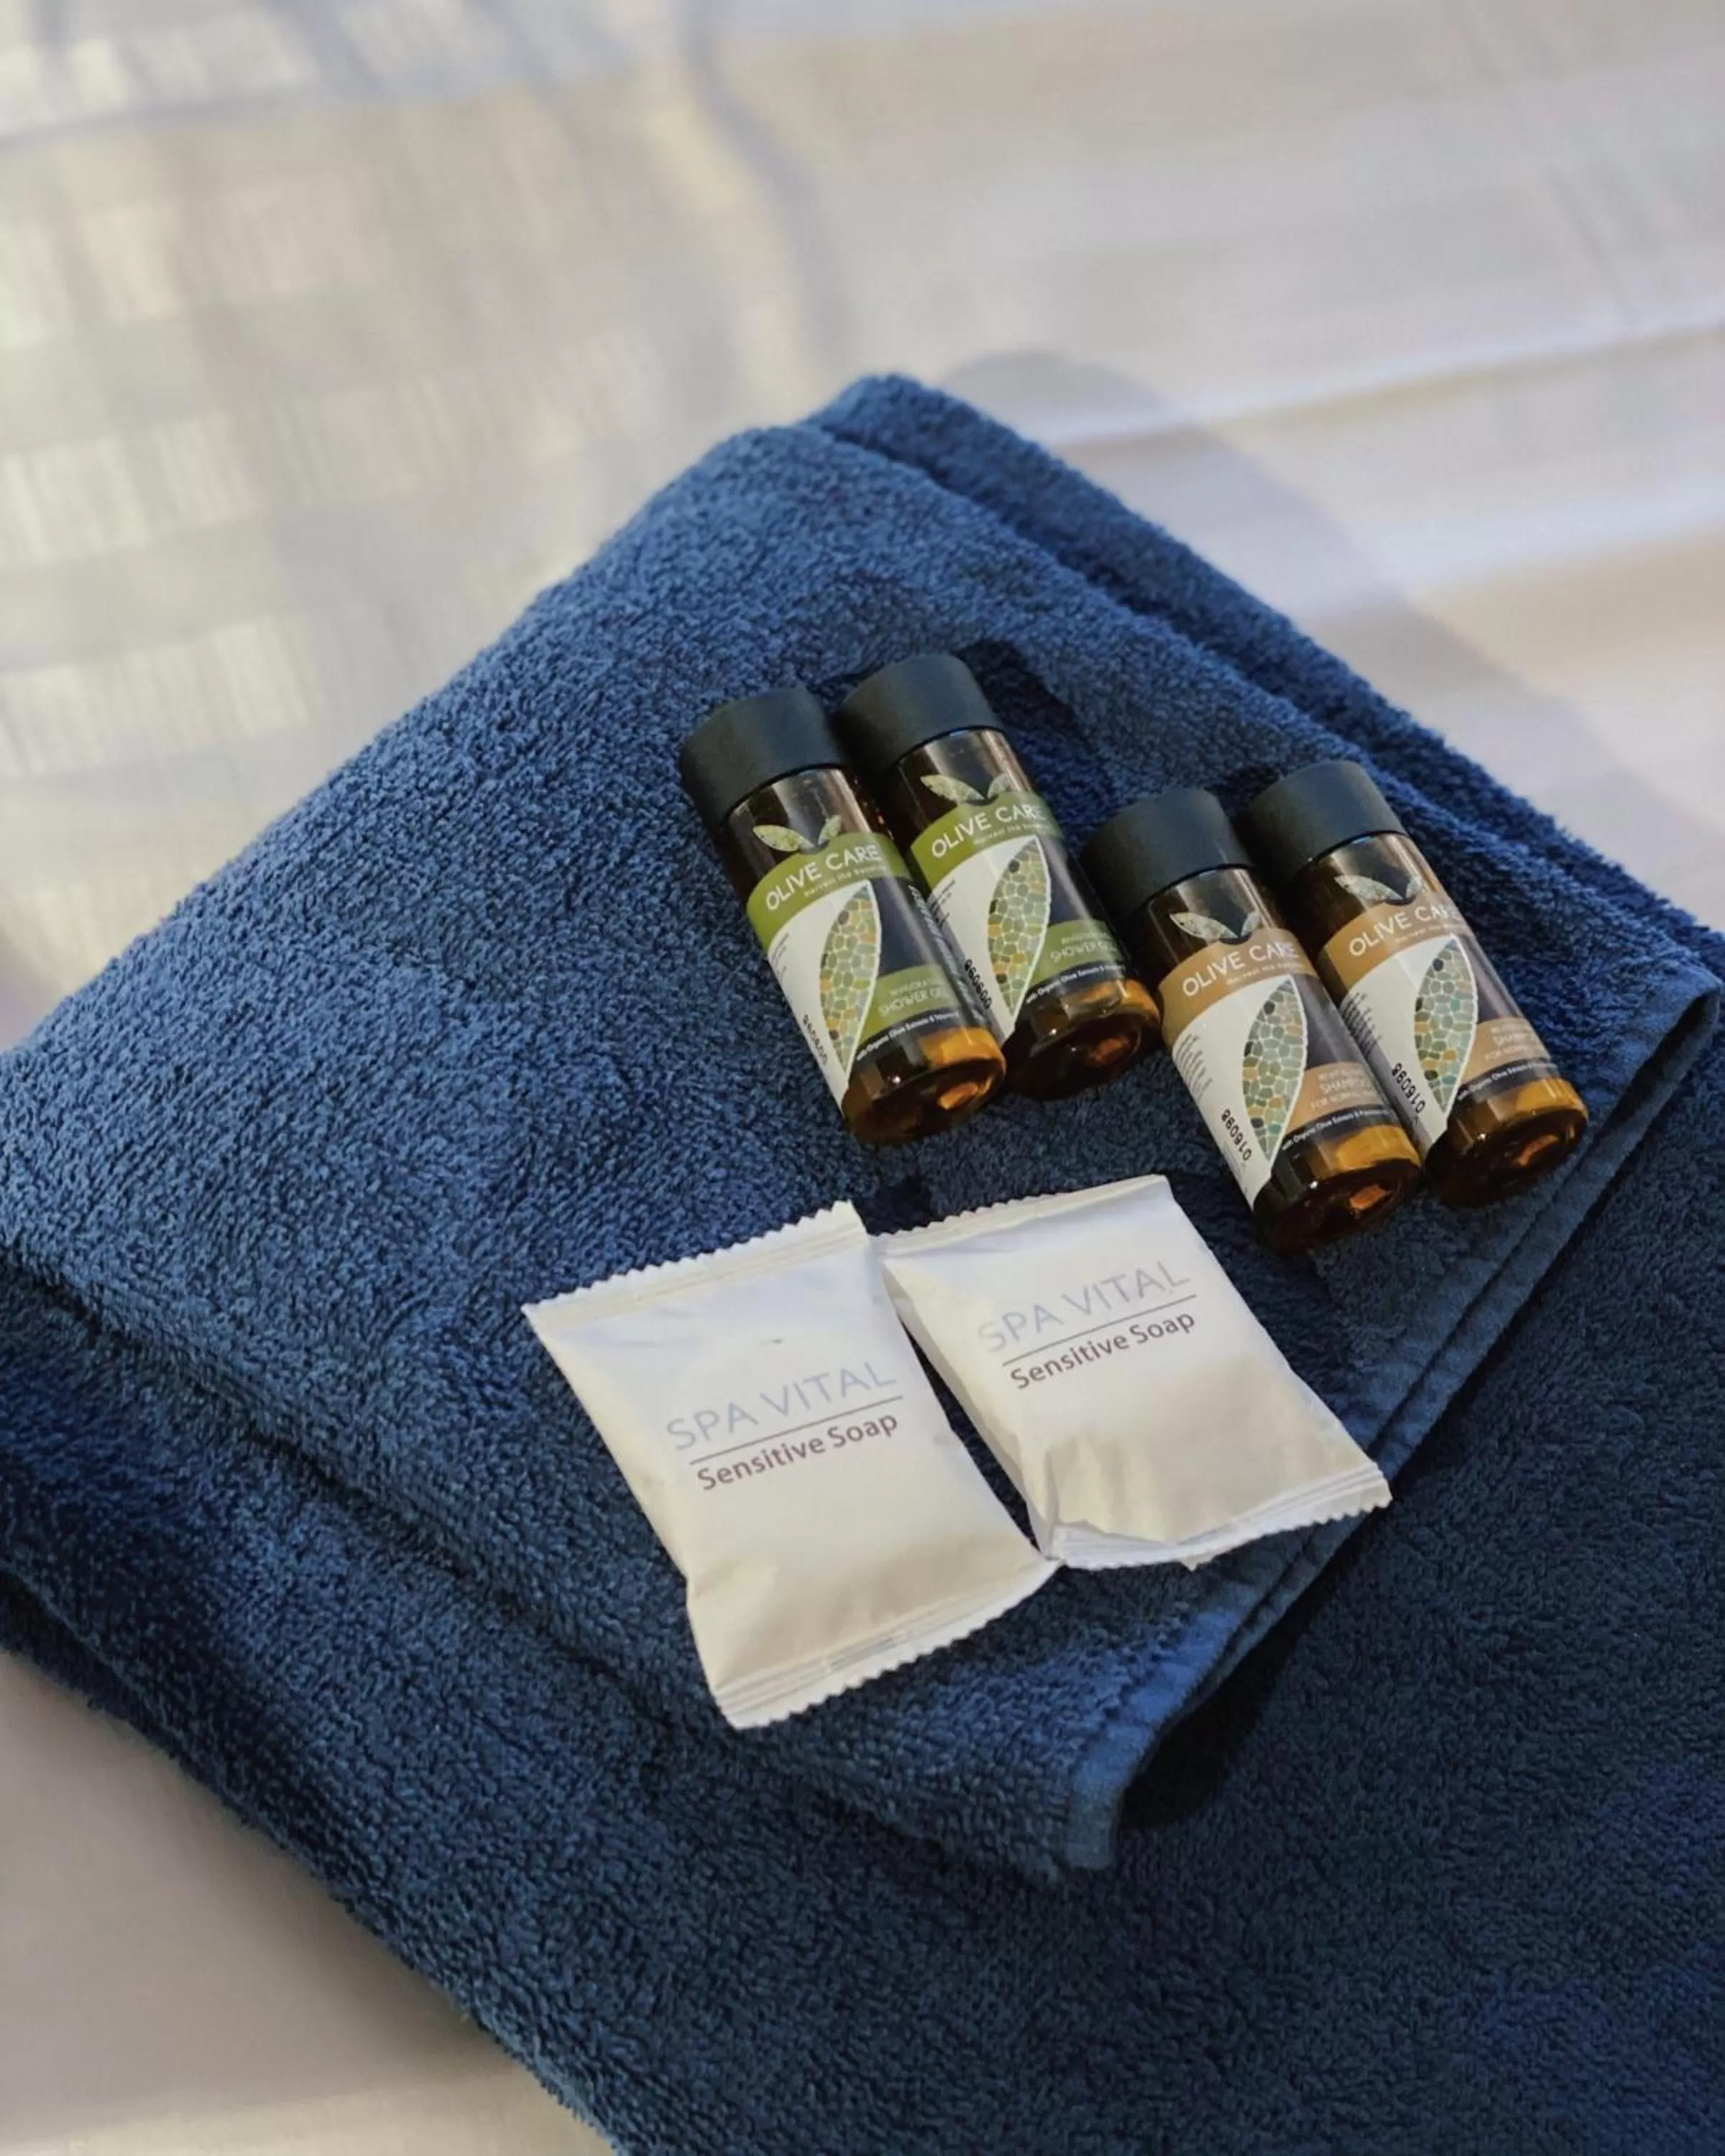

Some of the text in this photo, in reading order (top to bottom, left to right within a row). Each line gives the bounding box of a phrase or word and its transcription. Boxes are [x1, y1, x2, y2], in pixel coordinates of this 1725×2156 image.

[932, 811, 991, 858] OLIVE
[766, 844, 882, 910] OLIVE CARE
[1182, 942, 1300, 996] OLIVE CARE
[1349, 911, 1412, 957] OLIVE
[978, 1260, 1192, 1353] SPA VITAL
[1011, 1310, 1196, 1390] Sensitive Soap
[666, 1361, 897, 1451] SPA VITAL
[696, 1411, 898, 1491] Sensitive Soap
